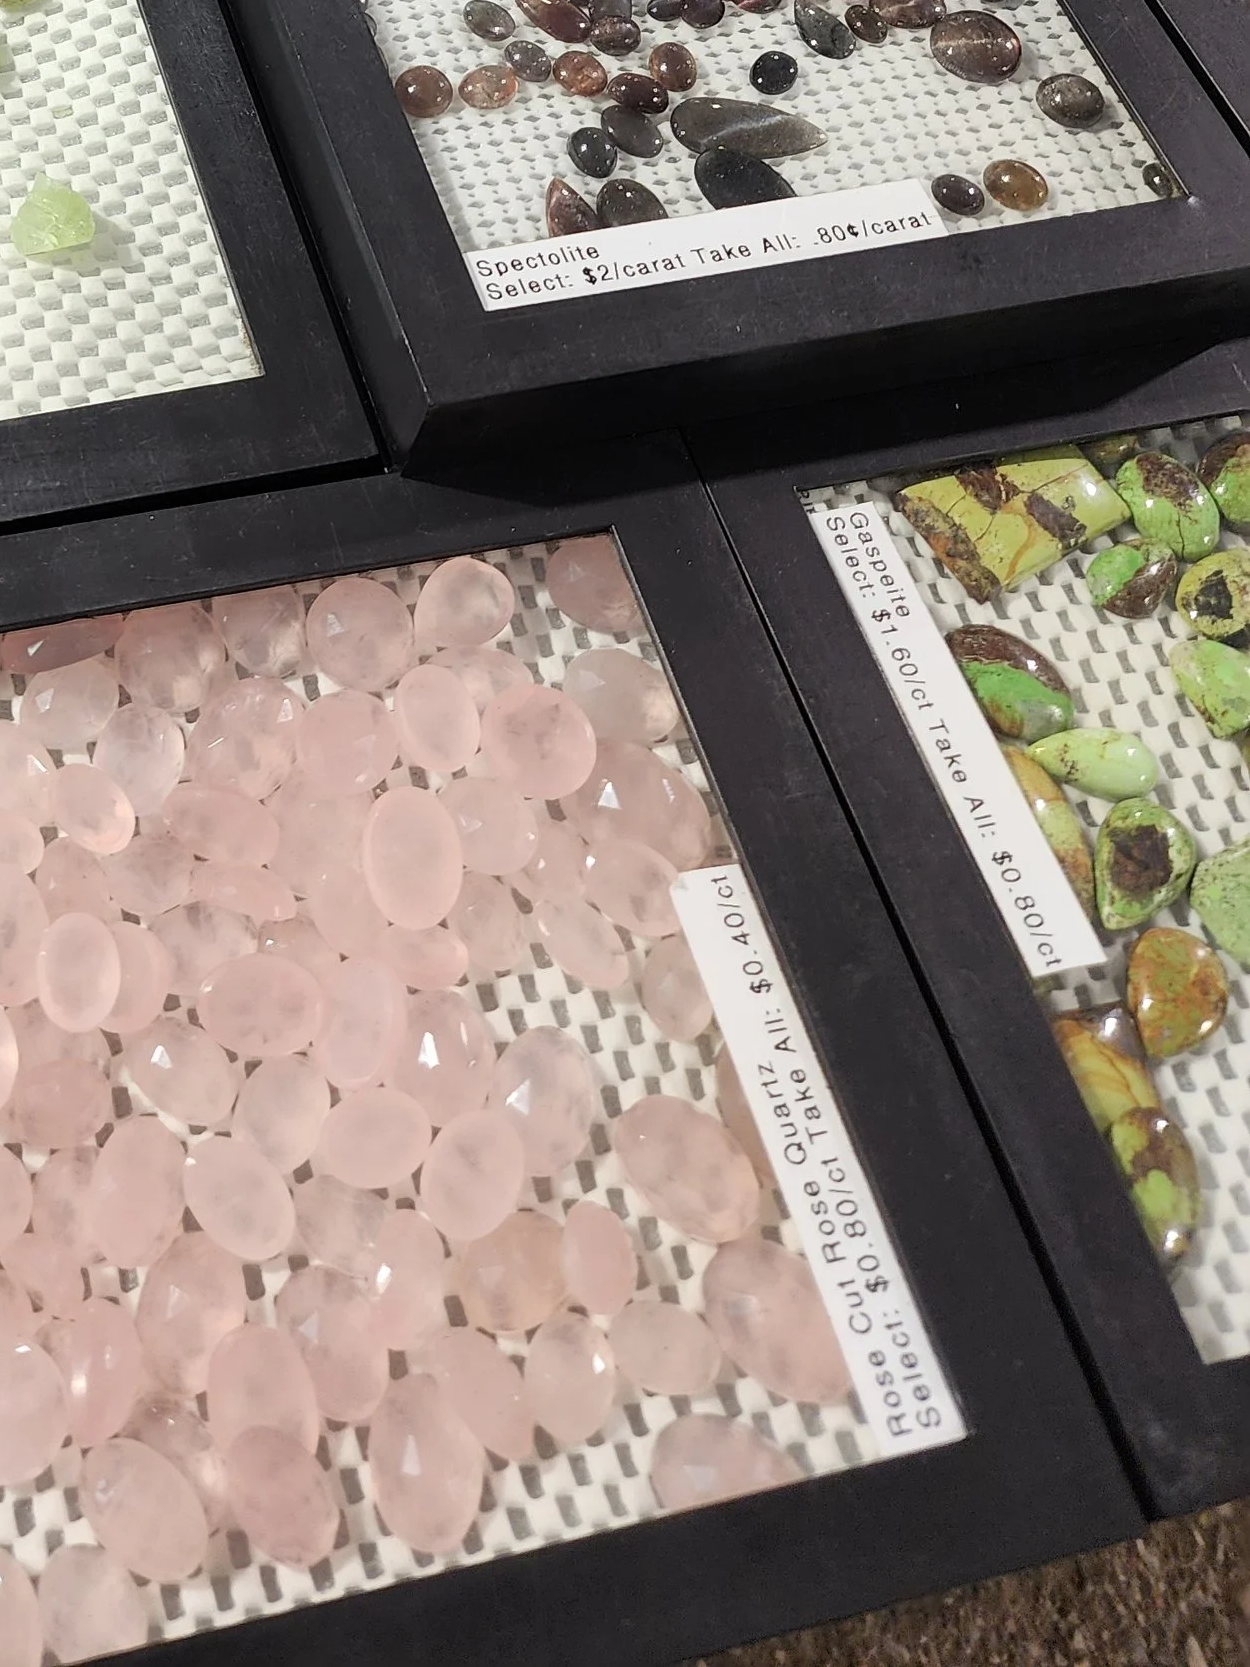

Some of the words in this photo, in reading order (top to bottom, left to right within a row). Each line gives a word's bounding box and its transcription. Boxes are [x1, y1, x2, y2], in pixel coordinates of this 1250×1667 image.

[476, 242, 601, 279] Spectolite
[485, 272, 575, 302] Select:
[582, 252, 688, 286] $2/carat
[690, 241, 753, 267] Take
[761, 233, 802, 255] All:
[812, 210, 933, 248] .80¢/carat
[849, 511, 911, 618] Gaspeite
[826, 515, 876, 599] Select:
[870, 608, 935, 711] $1.60/ct
[928, 717, 968, 784] Take
[962, 794, 997, 839] All:
[990, 849, 1063, 968] $0.80/ct
[710, 874, 775, 995] $0.40/ct
[764, 1007, 798, 1054] All:
[757, 1060, 808, 1166] Quartz
[789, 1068, 829, 1146] Take
[803, 1180, 847, 1265] Rose
[820, 1156, 890, 1294] $0.80/ct
[836, 1278, 873, 1336] Cut
[867, 1349, 914, 1438] Rose
[883, 1309, 943, 1429] Select:
